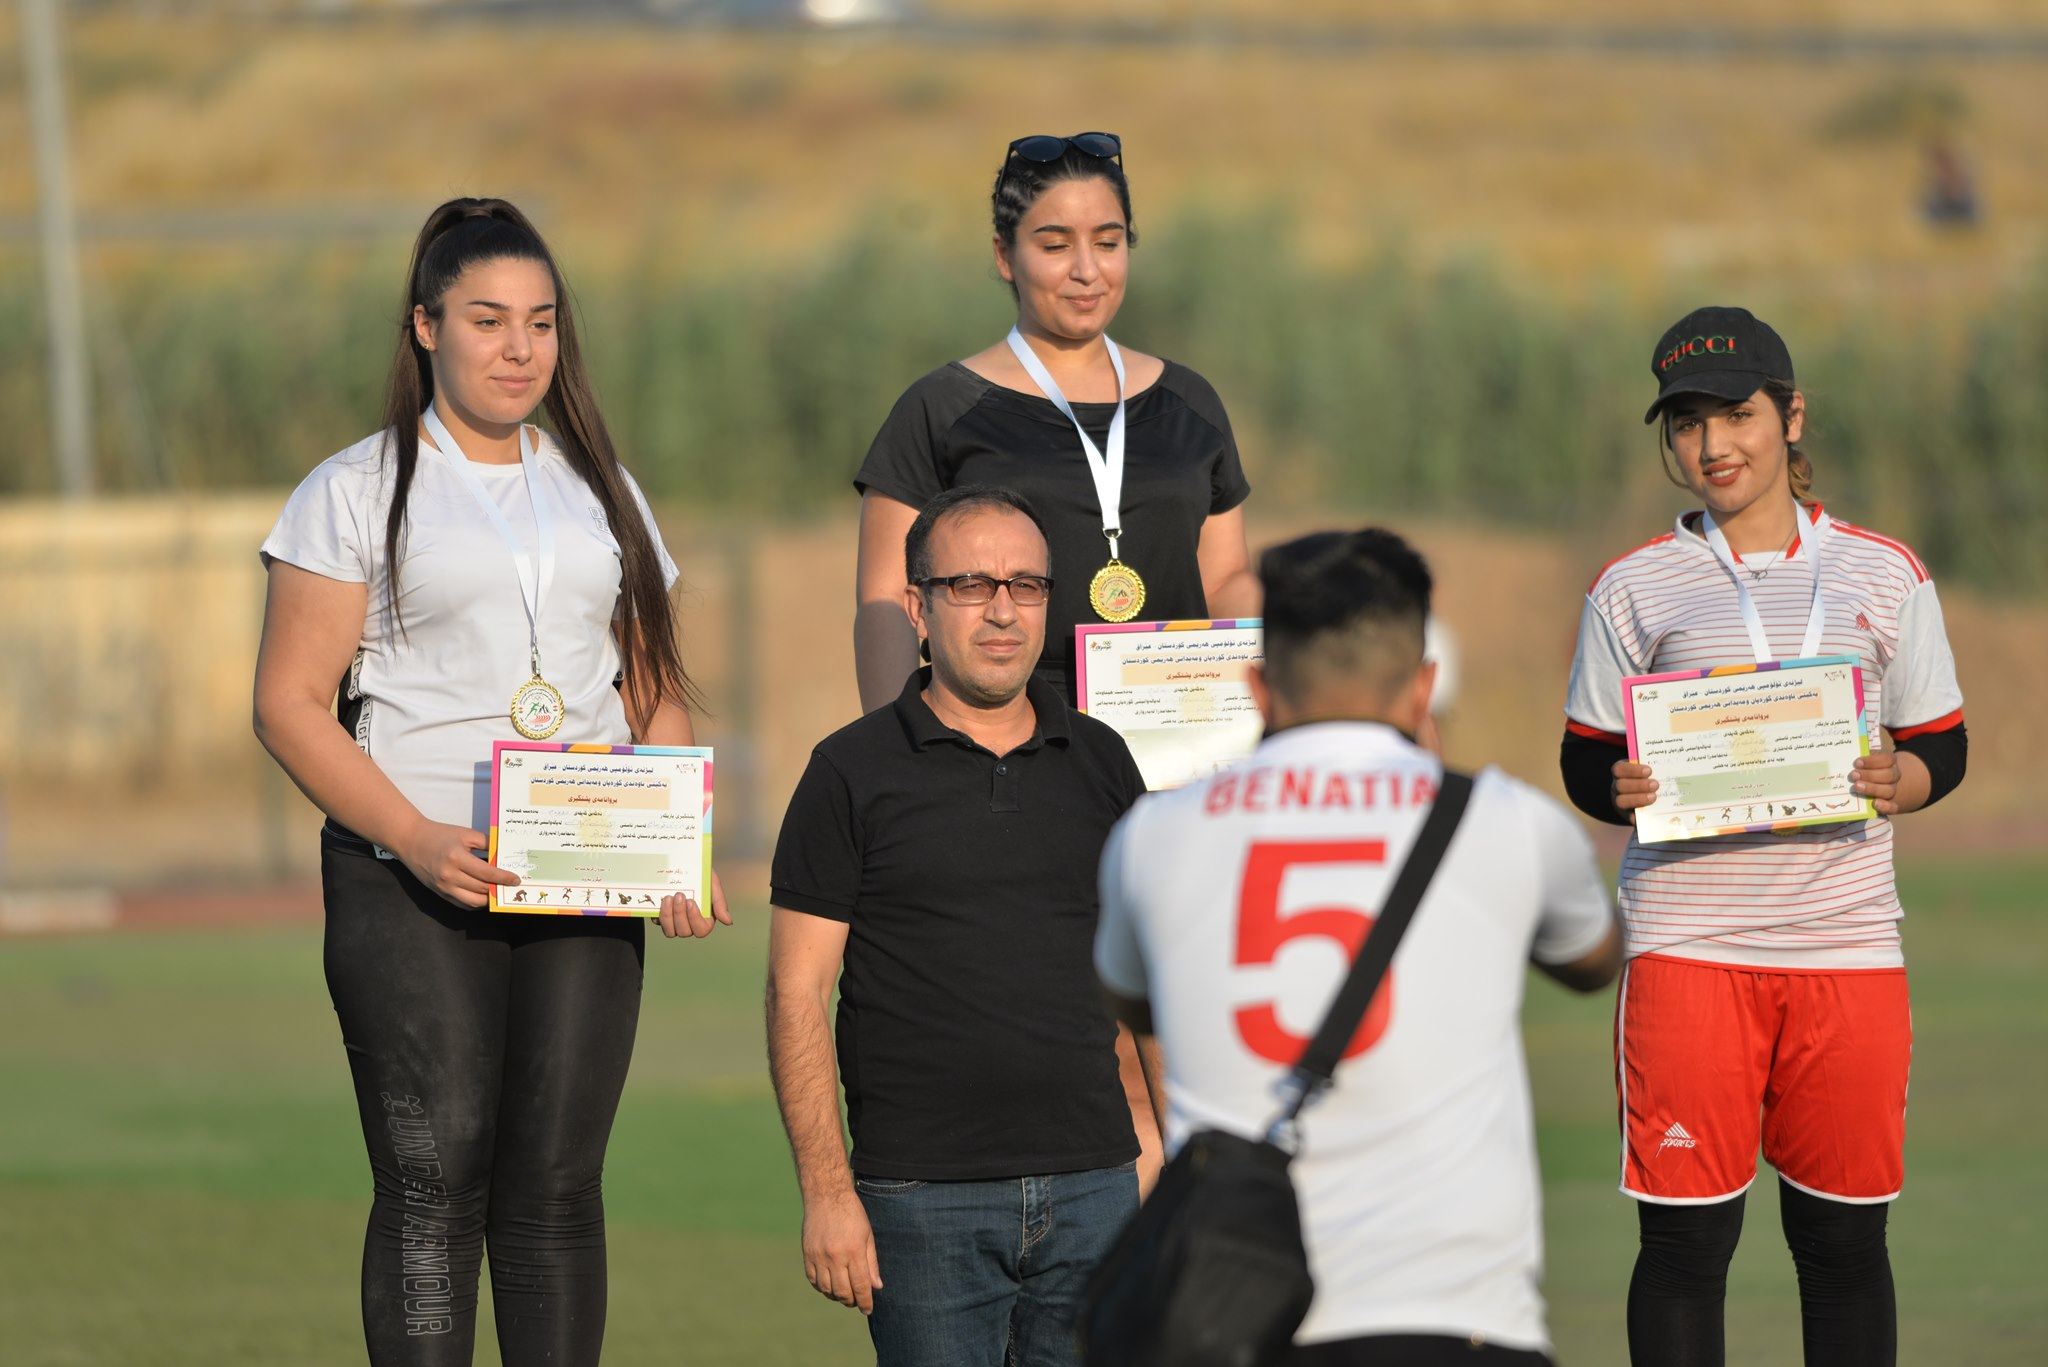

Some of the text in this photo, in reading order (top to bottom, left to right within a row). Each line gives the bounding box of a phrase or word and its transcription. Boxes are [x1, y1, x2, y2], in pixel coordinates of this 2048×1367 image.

[1660, 336, 1736, 372] GUCCI
[1202, 766, 1438, 815] BENATIA
[1232, 837, 1394, 1067] 5
[387, 1117, 453, 1336] UNDER ARMOUR
